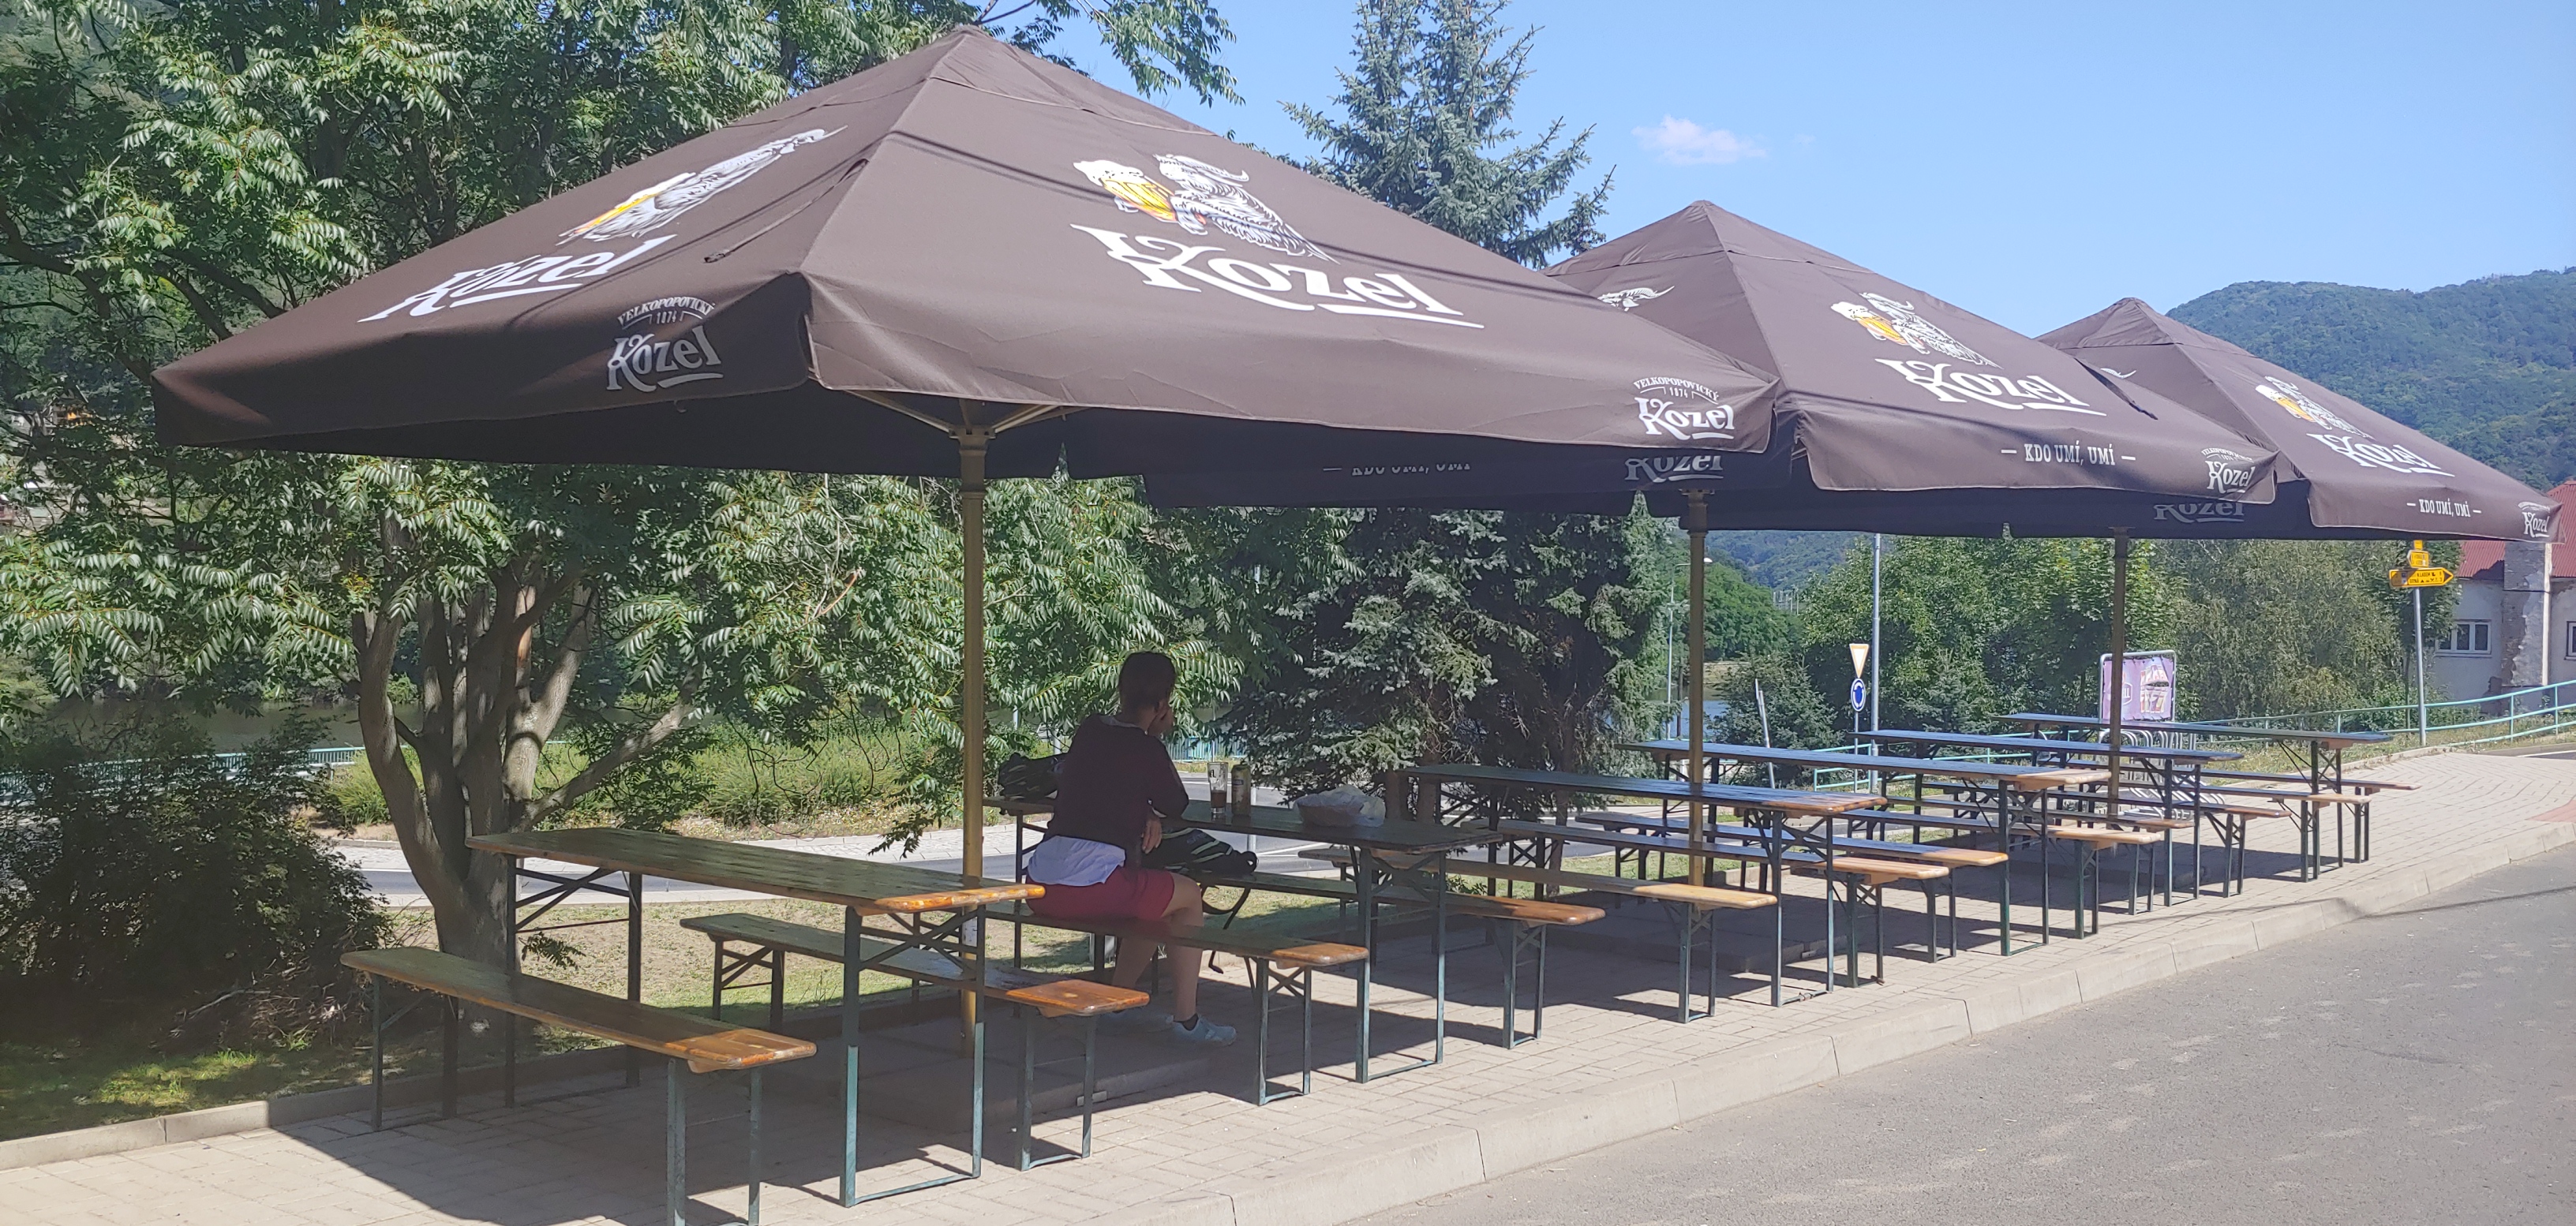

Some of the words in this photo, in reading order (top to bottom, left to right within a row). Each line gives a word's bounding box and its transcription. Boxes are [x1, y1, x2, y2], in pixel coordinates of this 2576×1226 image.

[358, 234, 678, 323] Kozel
[1070, 223, 1465, 316] Kozel
[617, 297, 716, 326] VELKOPOPOVICKÝ
[657, 311, 676, 324] 1874
[606, 326, 721, 392] Kozel
[1634, 377, 1719, 402] VELKOPOPOVICKÝ
[1669, 387, 1688, 398] 1874
[1874, 358, 2091, 410] Kozel
[1634, 397, 1735, 440] Kozel
[2024, 443, 2051, 462] KDO
[2054, 439, 2084, 465] UMÍ,
[2087, 443, 2115, 465] UMÍ
[2307, 433, 2442, 473] Kozel
[2205, 461, 2256, 494] Kozel
[2419, 499, 2435, 513] KDO
[2522, 512, 2550, 537] Kozel
